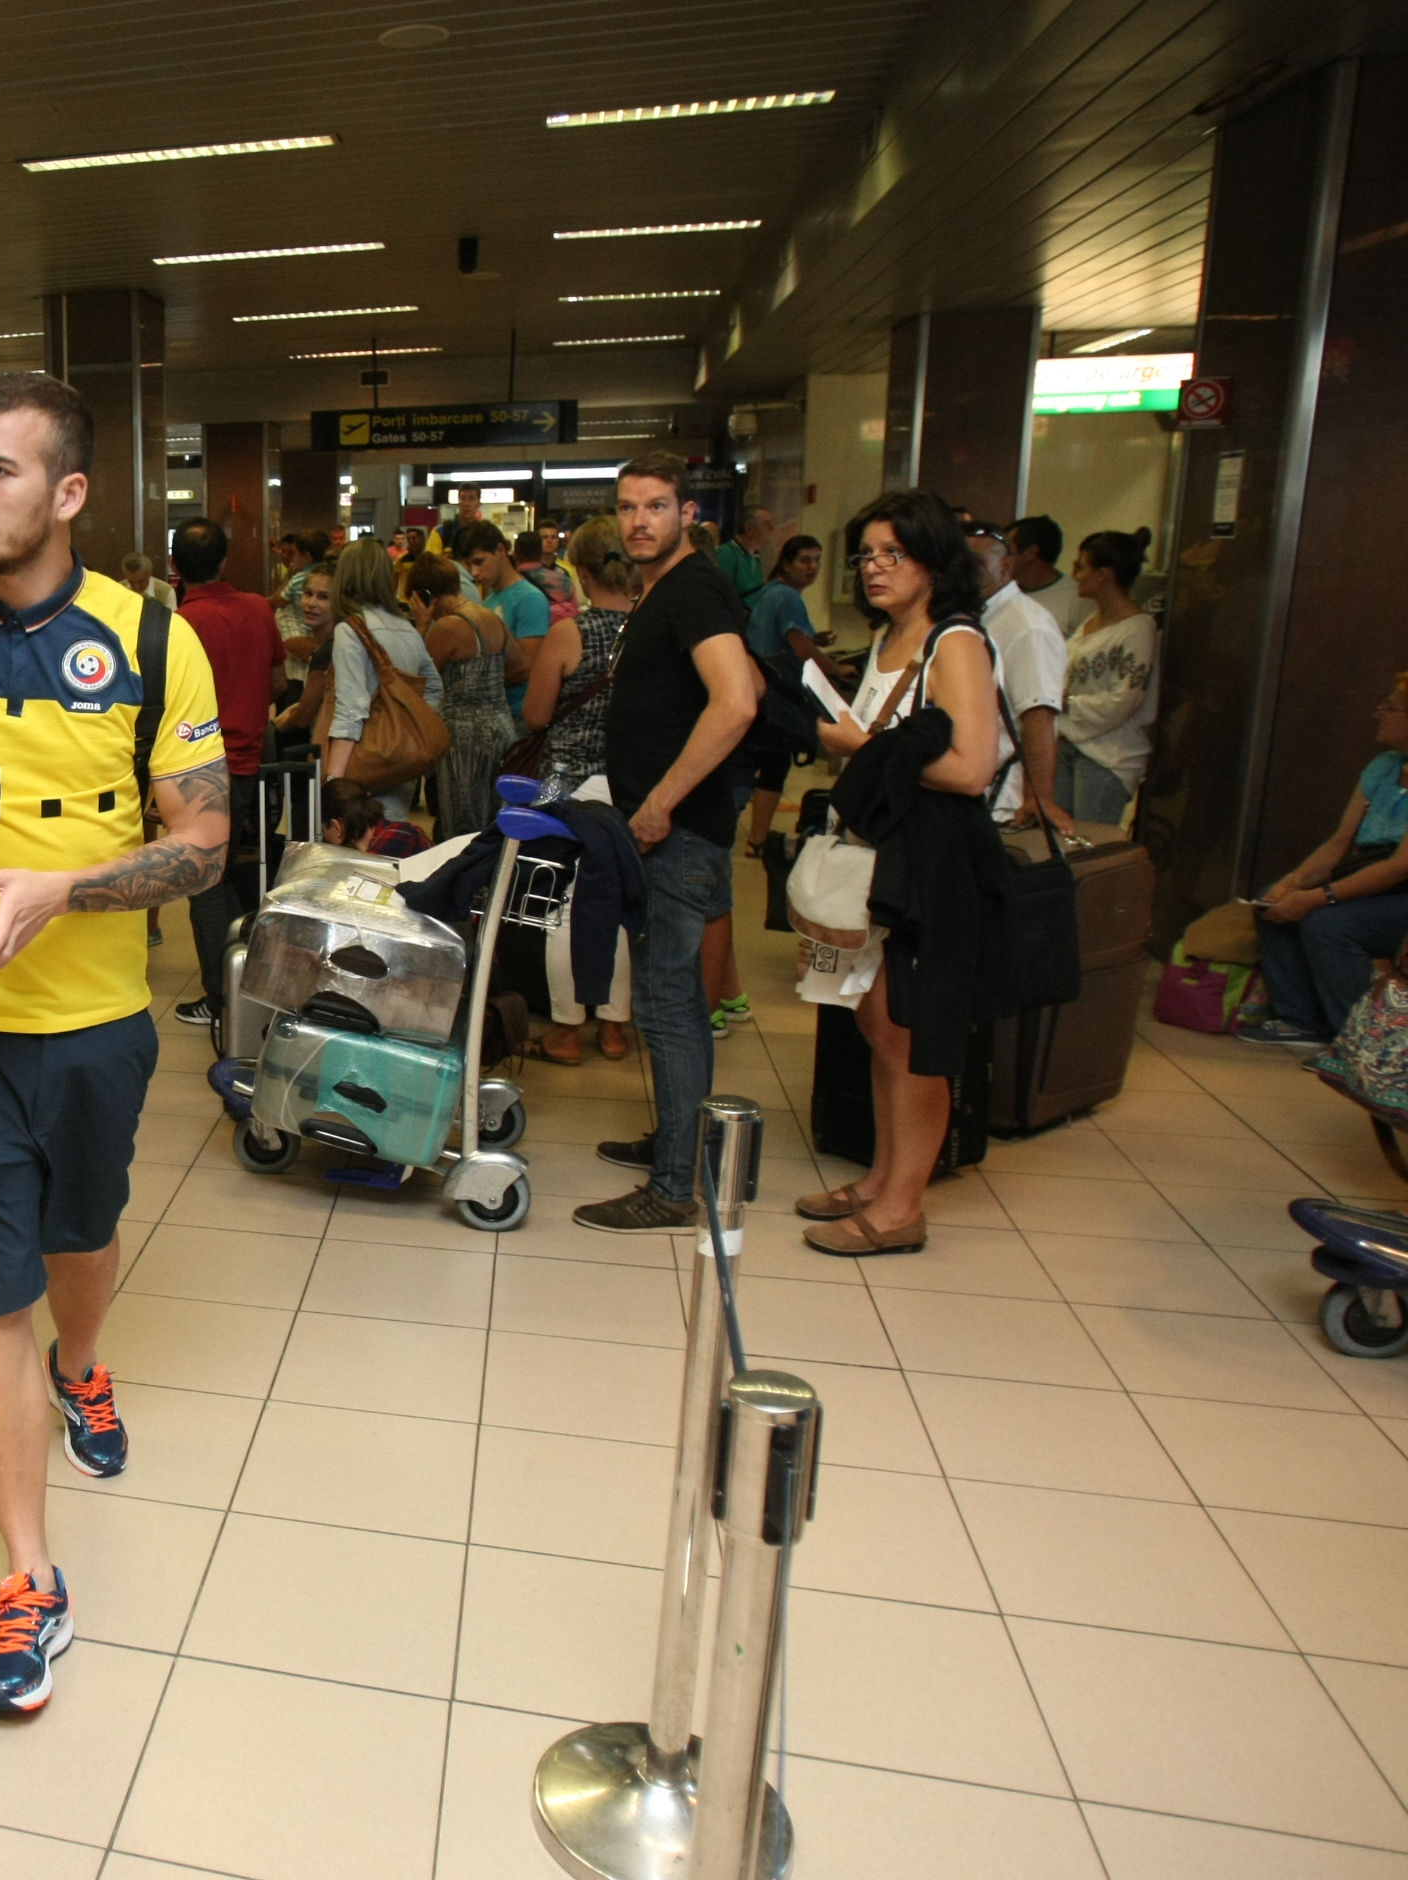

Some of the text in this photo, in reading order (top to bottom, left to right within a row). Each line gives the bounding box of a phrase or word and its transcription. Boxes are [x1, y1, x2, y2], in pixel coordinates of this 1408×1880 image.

[490, 409, 529, 423] 50-57
[372, 430, 445, 445] Gates 50-57
